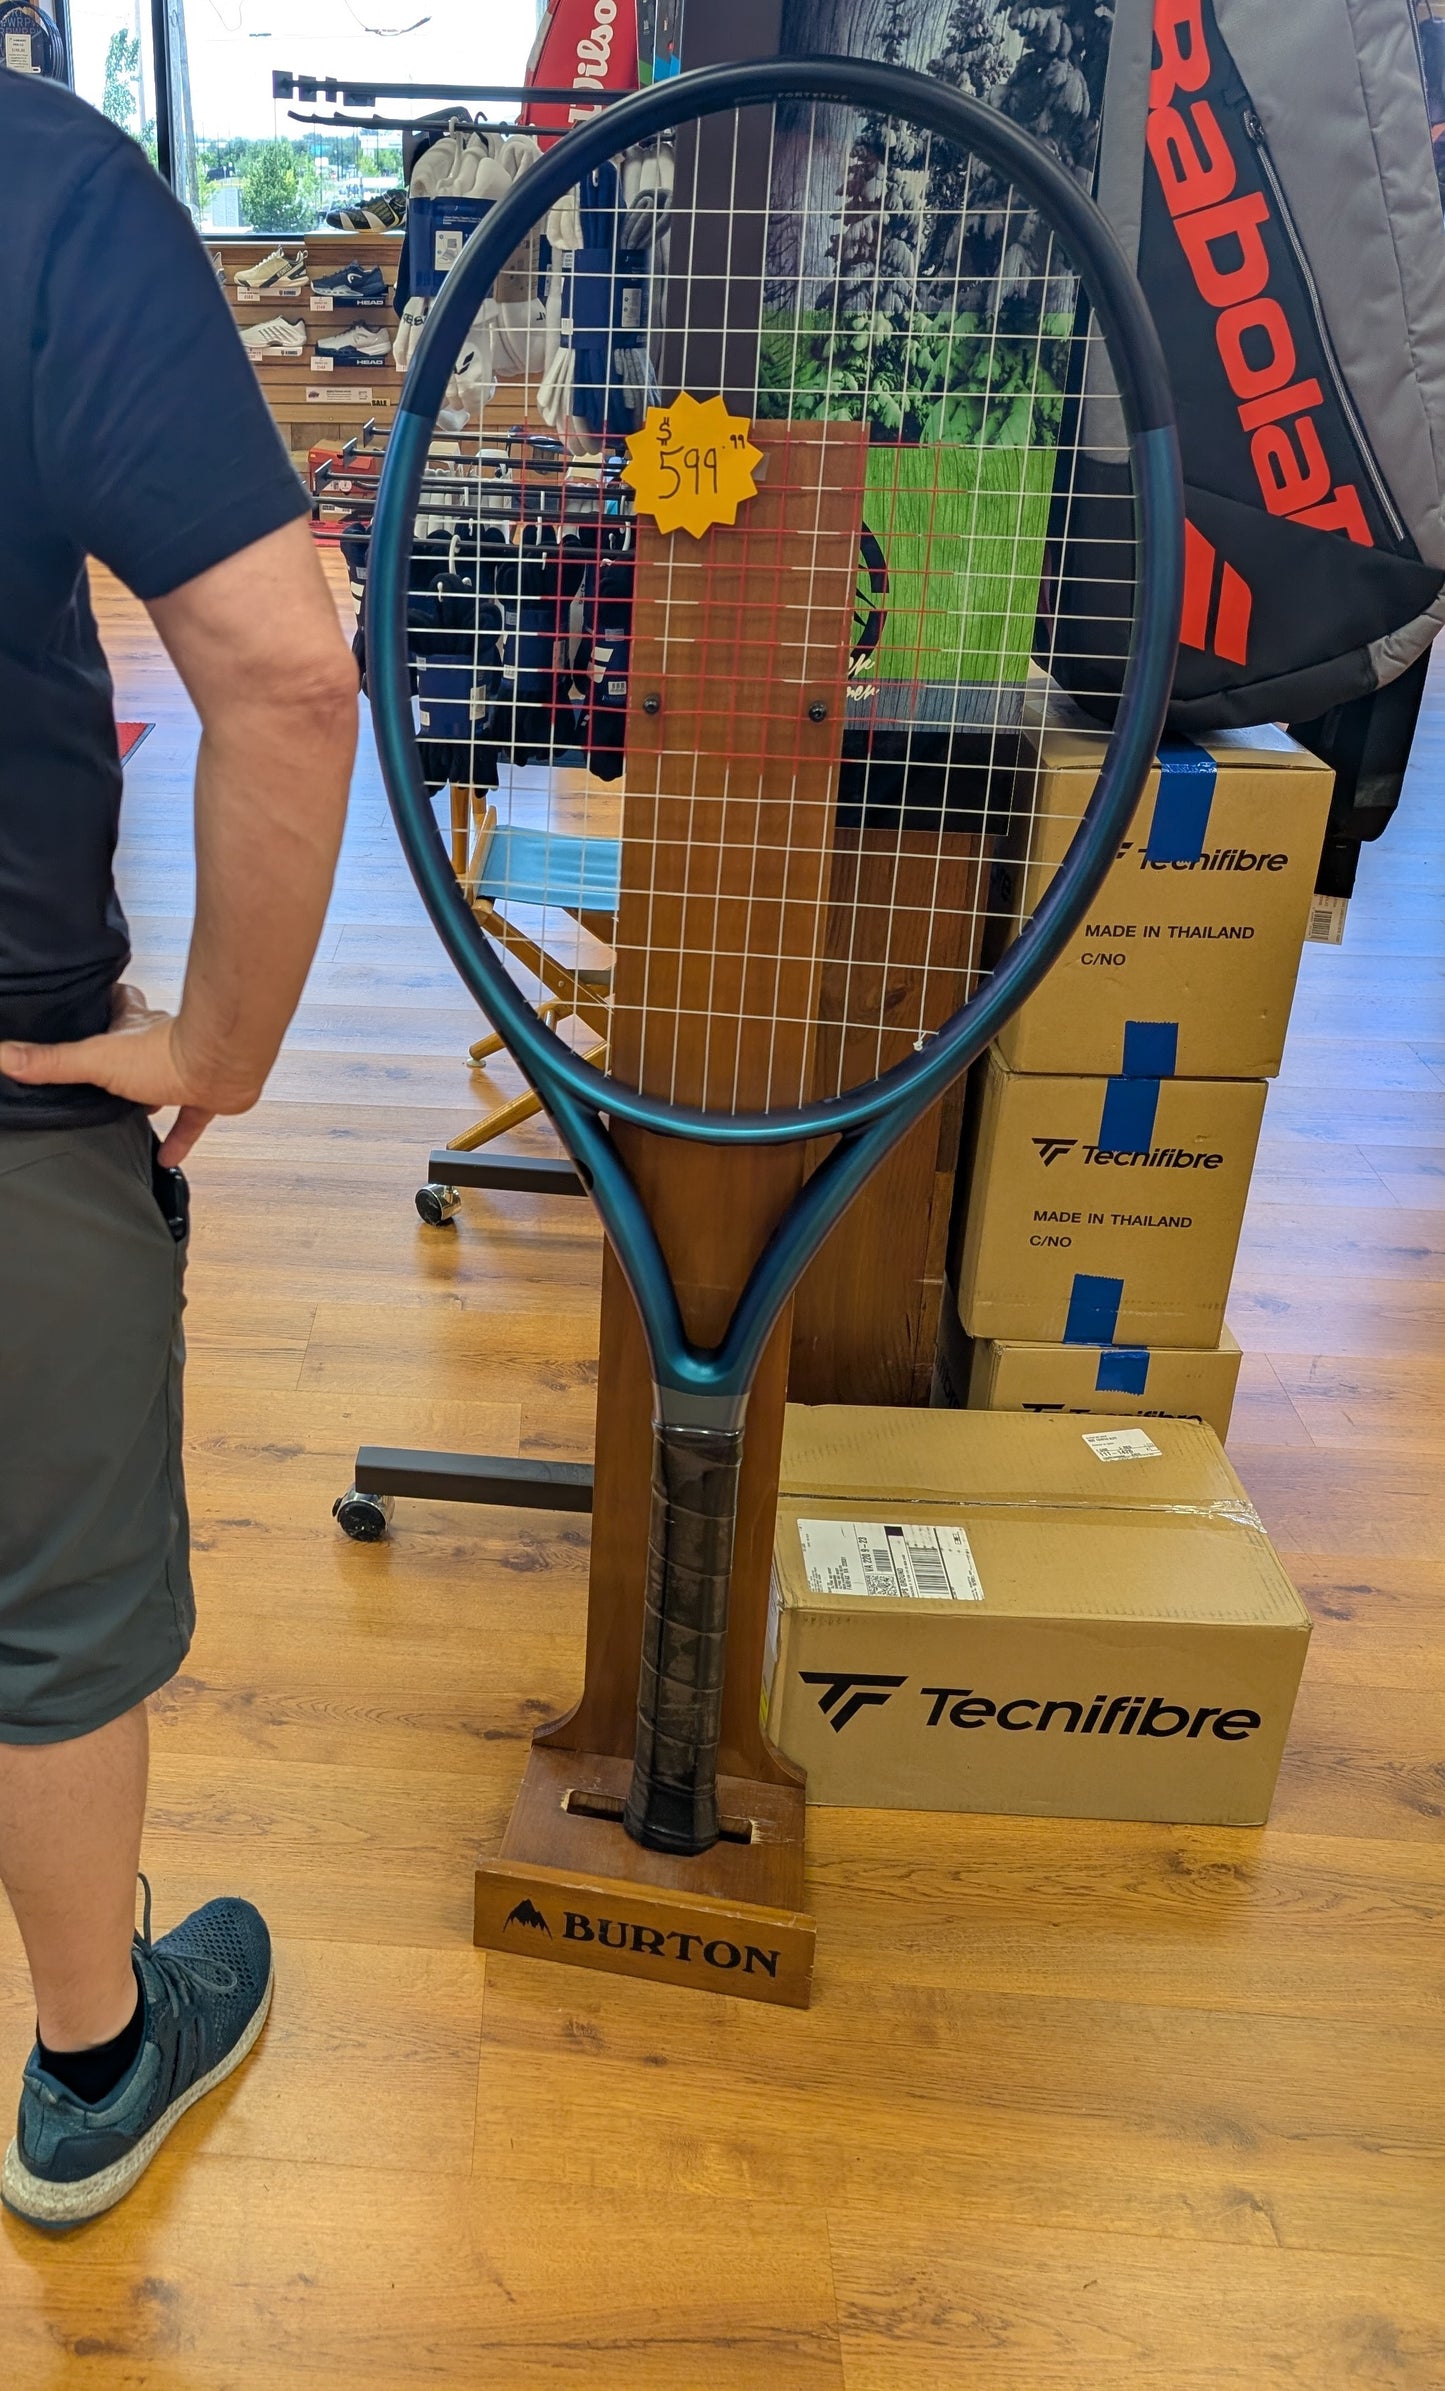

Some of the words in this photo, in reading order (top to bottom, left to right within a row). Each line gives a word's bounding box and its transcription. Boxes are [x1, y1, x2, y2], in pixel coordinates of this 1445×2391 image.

[1085, 925, 1137, 938] MADE
[1143, 926, 1161, 938] IN
[1168, 926, 1255, 939] THAILAND
[1081, 952, 1126, 966] C/NO
[1082, 1145, 1224, 1169] Tecnifibre
[1033, 1210, 1082, 1223] MADE
[1087, 1213, 1105, 1225] IN
[1111, 1214, 1193, 1228] THAILAND
[1029, 1235, 1072, 1248] C/NO
[919, 1687, 1262, 1741] Tecnifibre
[562, 1911, 781, 1978] BURTON
